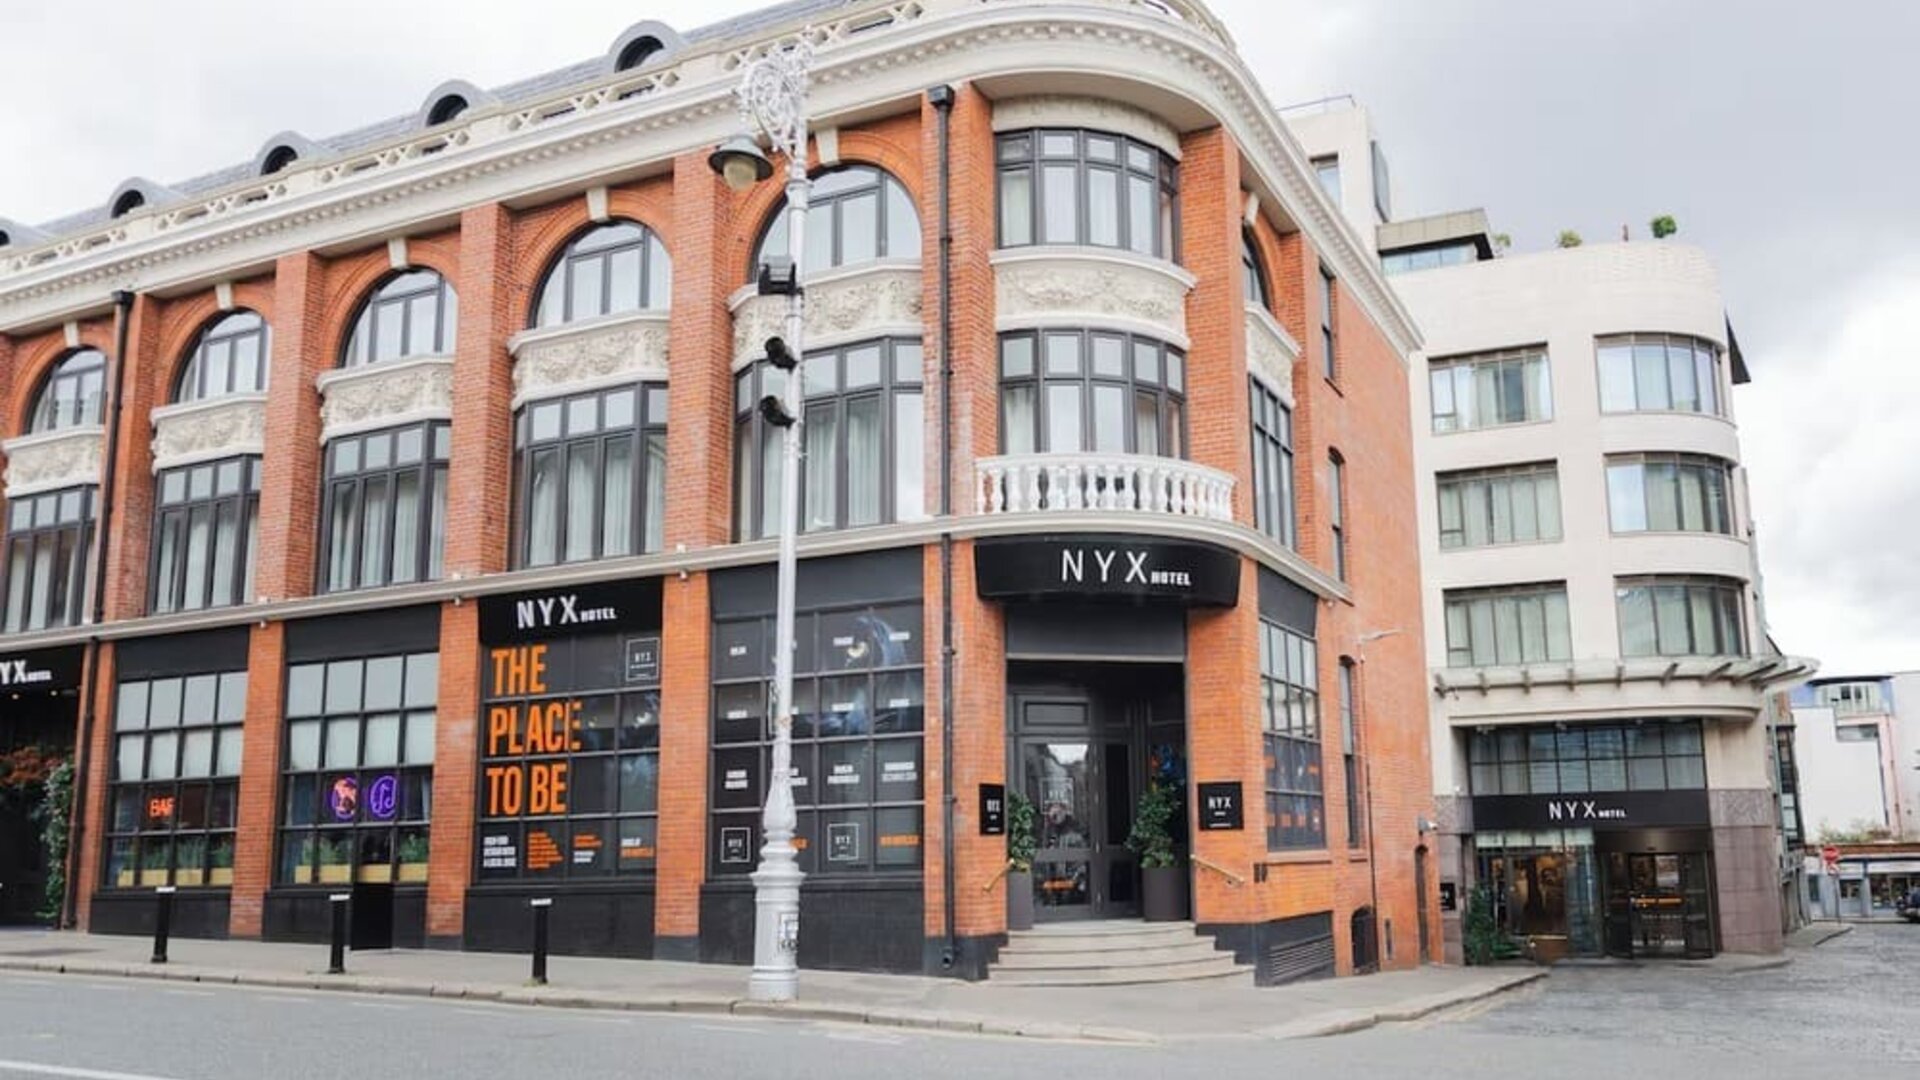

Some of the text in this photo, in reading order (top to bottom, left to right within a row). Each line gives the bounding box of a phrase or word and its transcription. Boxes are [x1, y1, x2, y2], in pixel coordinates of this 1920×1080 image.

[1062, 549, 1191, 585] NYX HOTEL
[517, 595, 579, 629] NYX
[491, 645, 547, 695] THE
[489, 701, 582, 755] PLACE
[486, 763, 566, 815] TO BE
[1208, 796, 1231, 809] NYX
[1549, 801, 1596, 819] NYX
